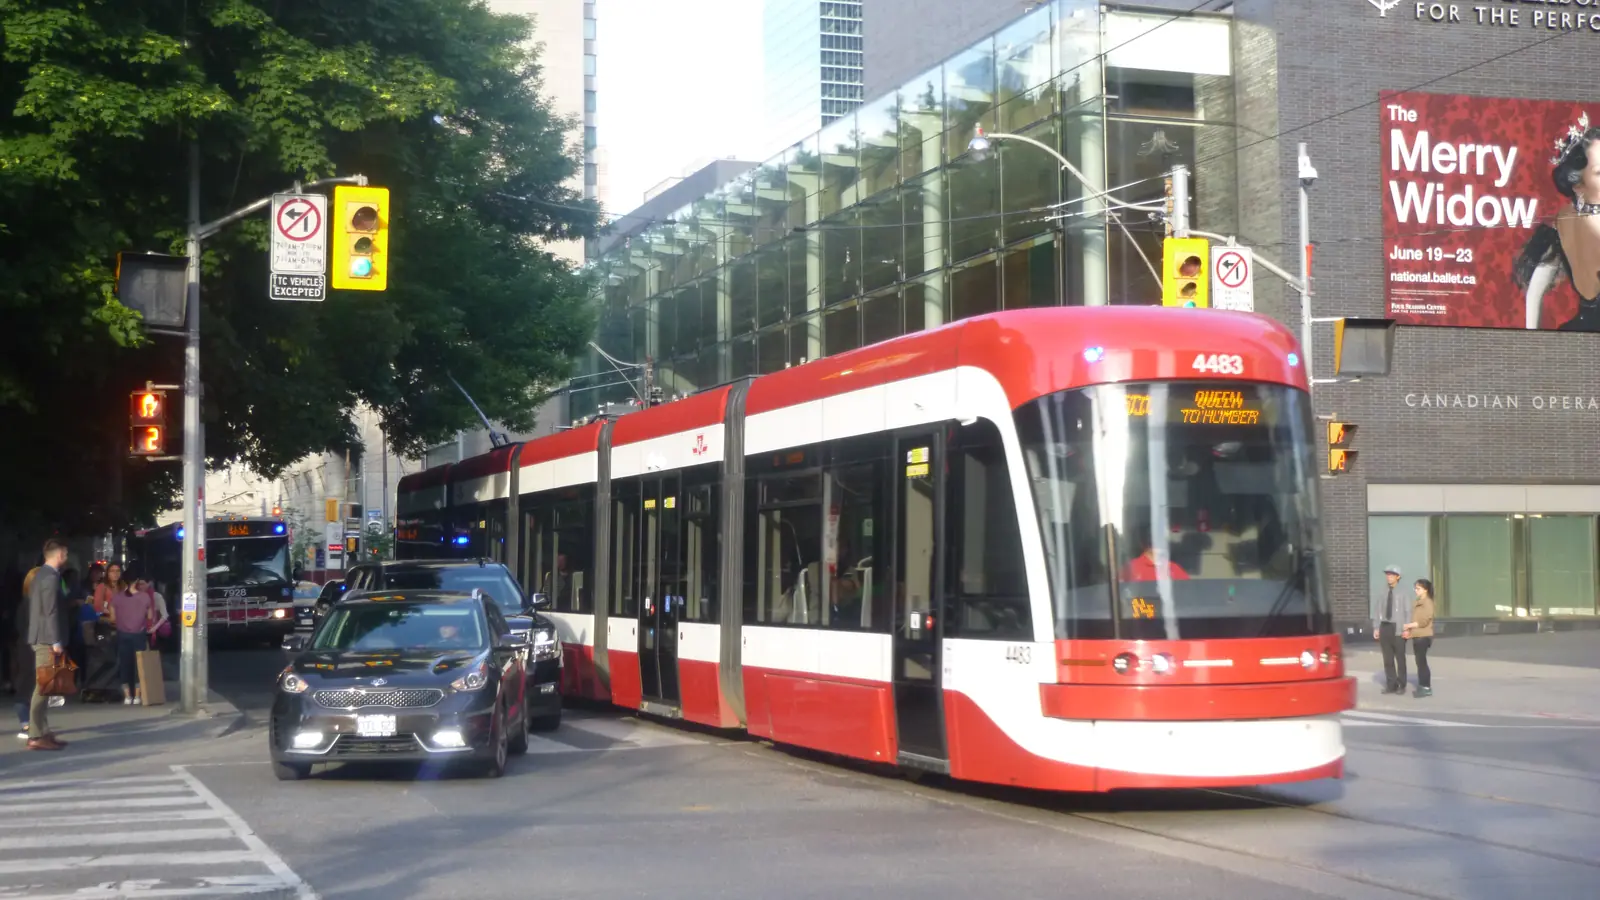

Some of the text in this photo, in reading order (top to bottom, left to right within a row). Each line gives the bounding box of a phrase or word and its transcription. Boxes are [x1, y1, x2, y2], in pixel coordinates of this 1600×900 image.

[1416, 2, 1460, 20] FOR
[1475, 7, 1519, 25] THE
[1387, 105, 1418, 122] The
[1390, 129, 1518, 188] Merry
[1389, 180, 1538, 228] Widow
[1390, 245, 1423, 260] June
[273, 275, 324, 287] TTC VEHICLES
[1390, 271, 1476, 285] national.ballet.ca
[274, 287, 321, 297] EXCEPTED
[1192, 353, 1244, 374] 4483
[1195, 390, 1244, 409] QUEEN
[1405, 393, 1599, 410] CANADIAN OPERA
[1181, 408, 1259, 424] TO HUMBER
[146, 427, 159, 451] 2
[223, 588, 247, 597] 7928
[1005, 645, 1031, 664] 4483
